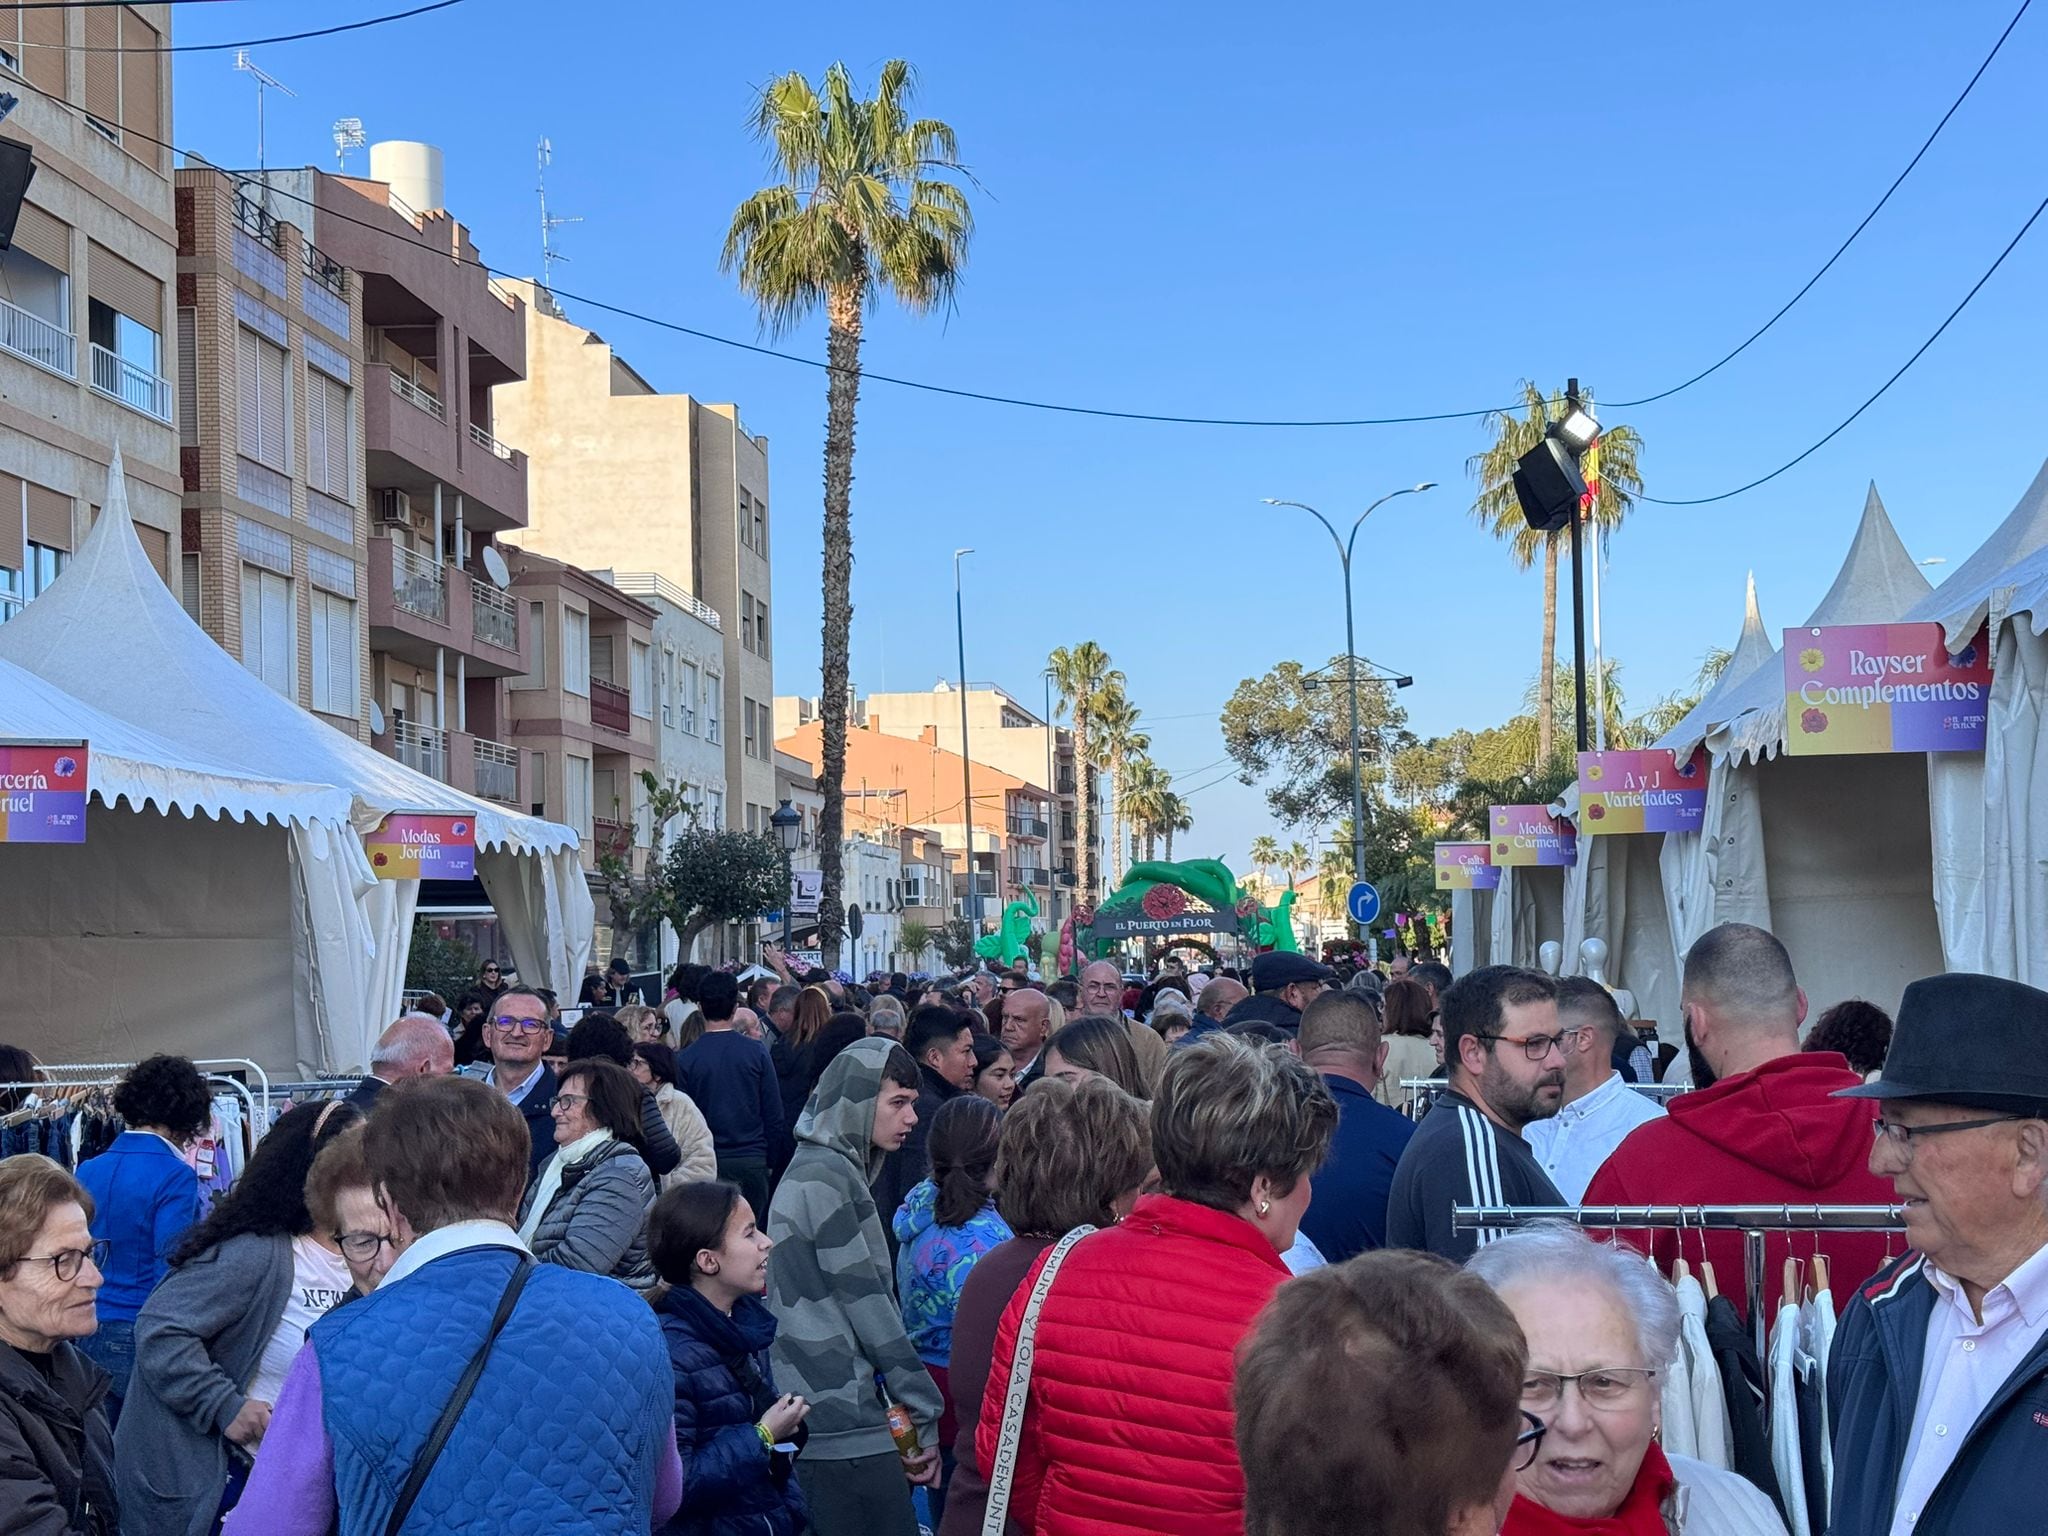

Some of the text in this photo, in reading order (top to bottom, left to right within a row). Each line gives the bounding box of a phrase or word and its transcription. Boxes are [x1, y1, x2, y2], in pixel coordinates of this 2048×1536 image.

[1850, 650, 1927, 680] Rayser
[1801, 677, 1980, 709] Complementos
[1624, 771, 1660, 792] A y J
[0, 792, 34, 812] ruel
[1603, 789, 1683, 808] Variedades
[401, 828, 441, 844] Modas
[1519, 822, 1554, 835] Modas
[399, 844, 441, 860] Jordán
[1513, 836, 1560, 849] Carmen
[1115, 922, 1126, 930] EL
[1127, 920, 1170, 931] PUERTO
[1183, 918, 1215, 929] FLOR
[1014, 1335, 1034, 1386] LOLA
[987, 1393, 1023, 1533] CASADEMUNT
